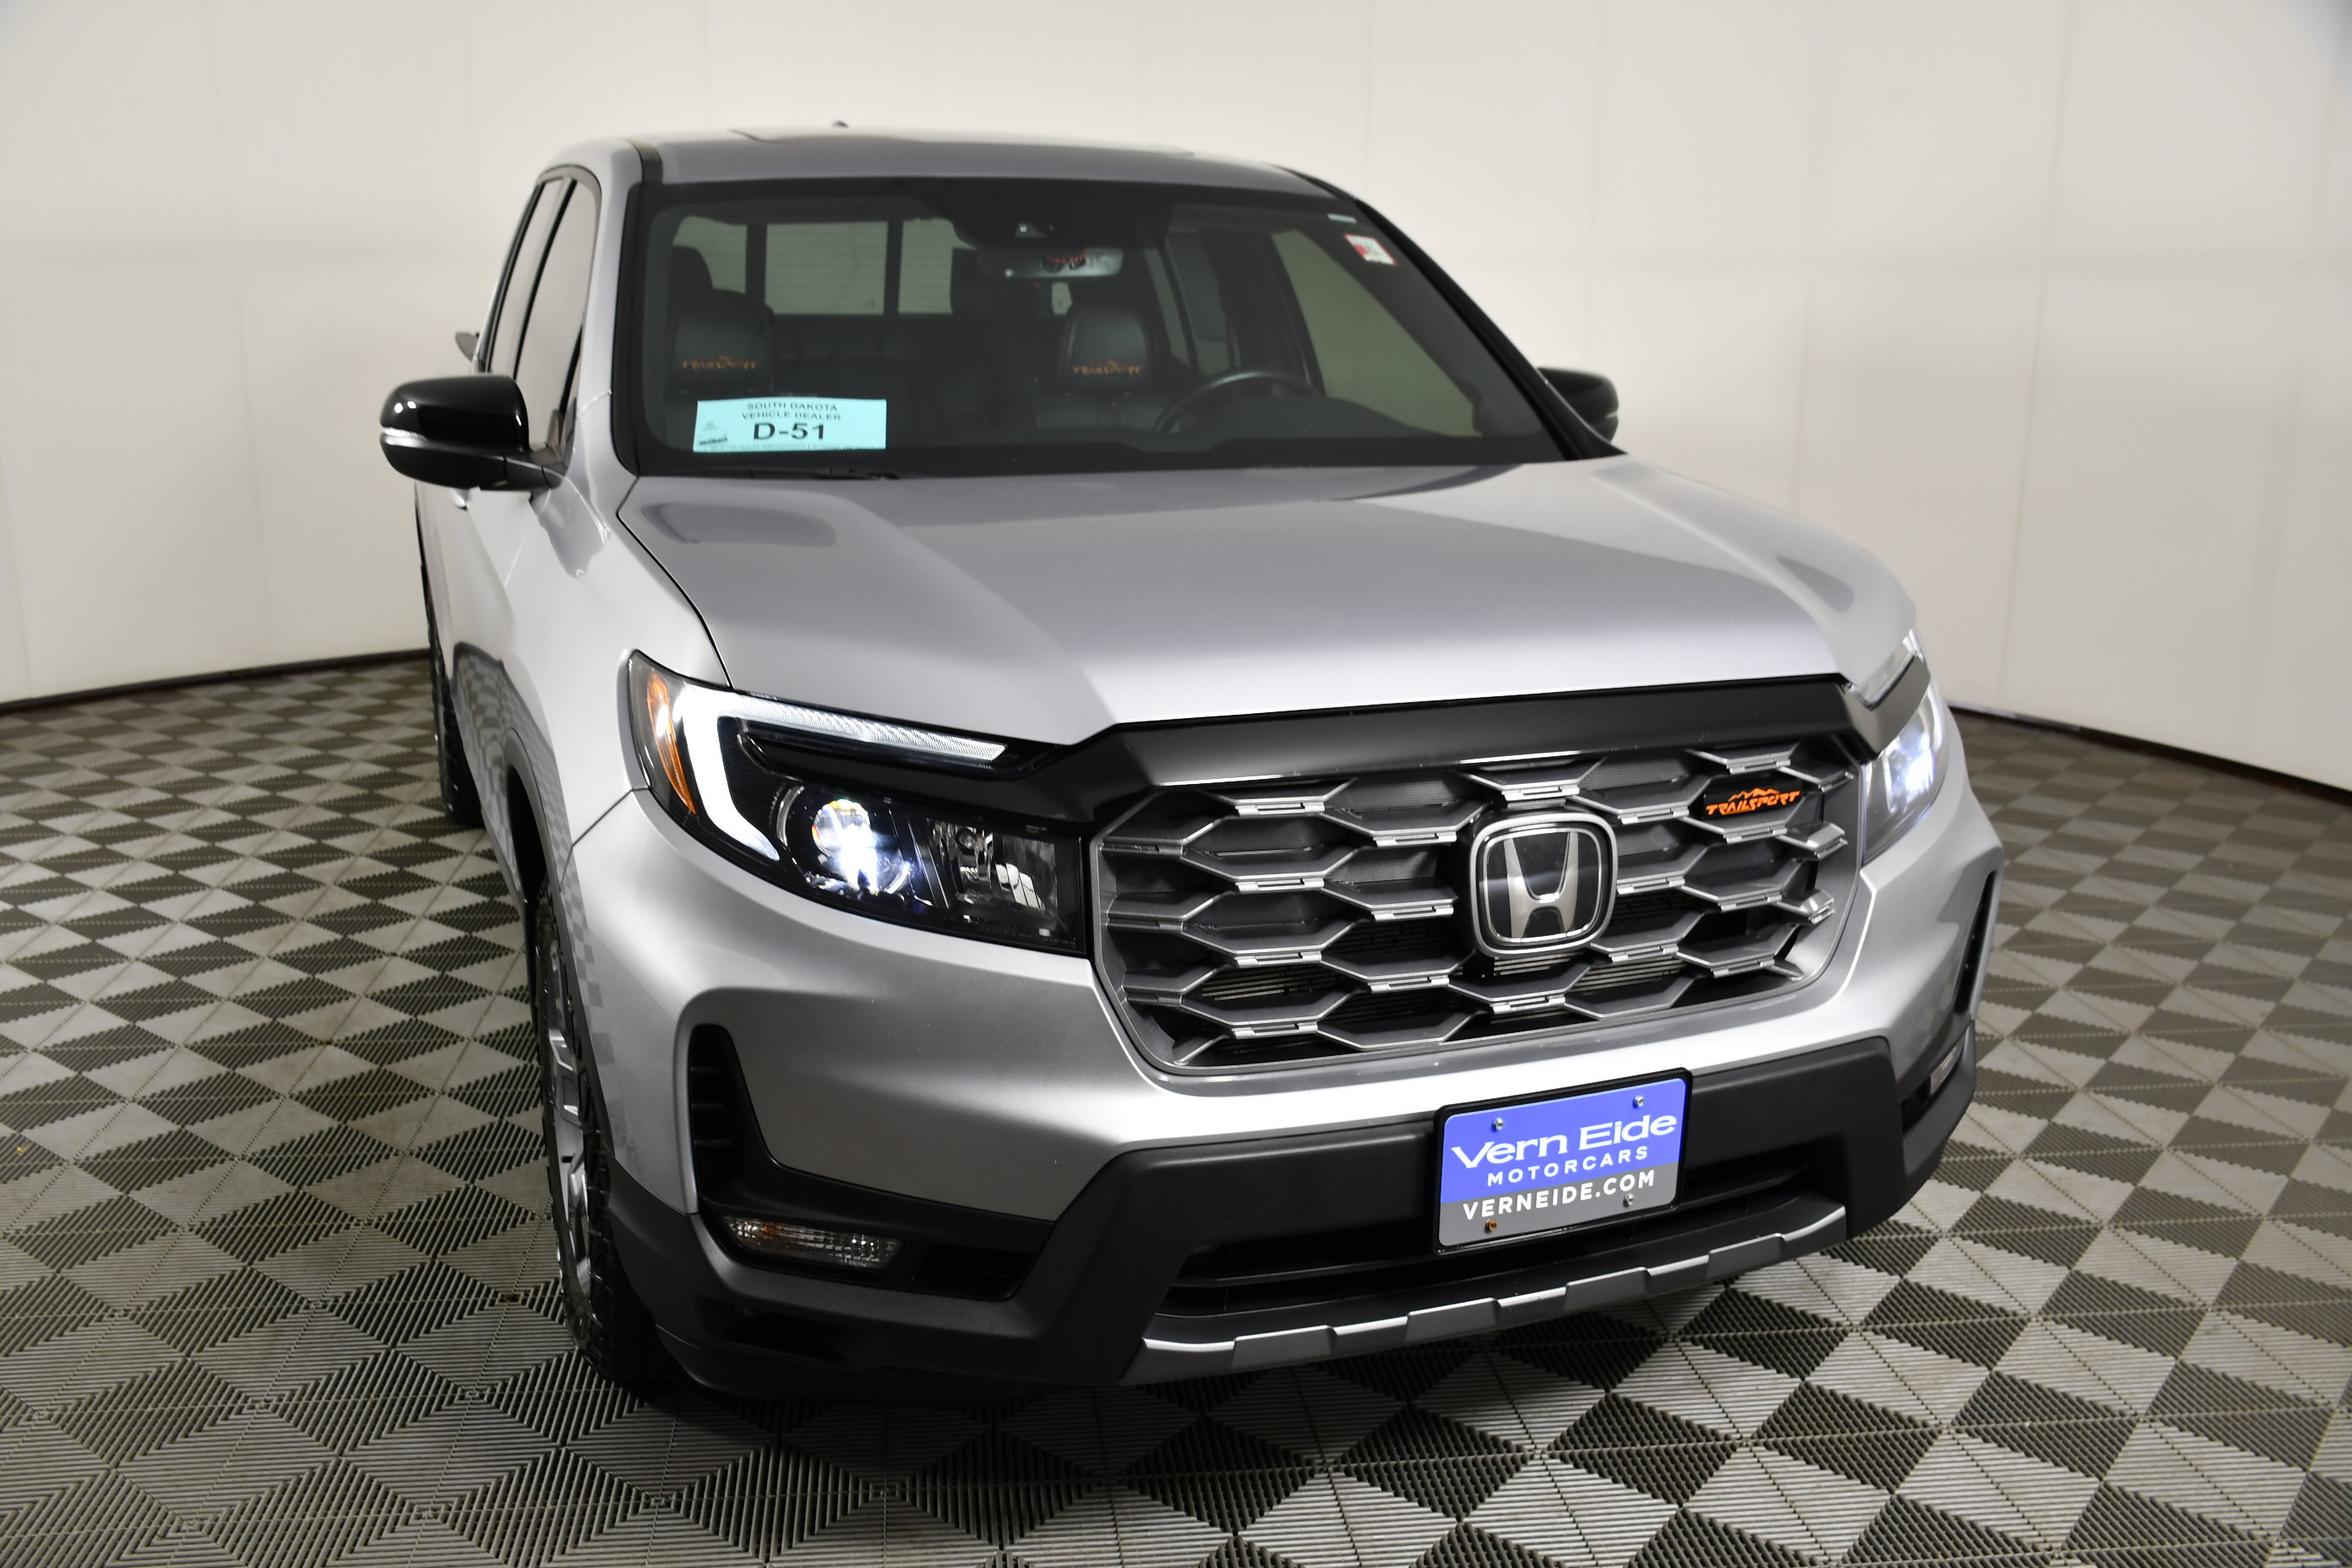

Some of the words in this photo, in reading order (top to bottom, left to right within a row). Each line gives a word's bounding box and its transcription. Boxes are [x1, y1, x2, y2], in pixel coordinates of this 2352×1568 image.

[742, 411, 791, 420] VEHICLE
[794, 411, 841, 422] DEALER
[747, 401, 787, 410] SOUTH
[790, 402, 838, 411] DAKOTA
[753, 422, 825, 440] D-51
[1706, 790, 1800, 815] TRAILSPORT
[1451, 1133, 1569, 1169] Vern
[1578, 1114, 1677, 1151] Eide
[1487, 1146, 1648, 1187] MOTORCARS
[1462, 1169, 1655, 1221] VERNEIDE.COM
